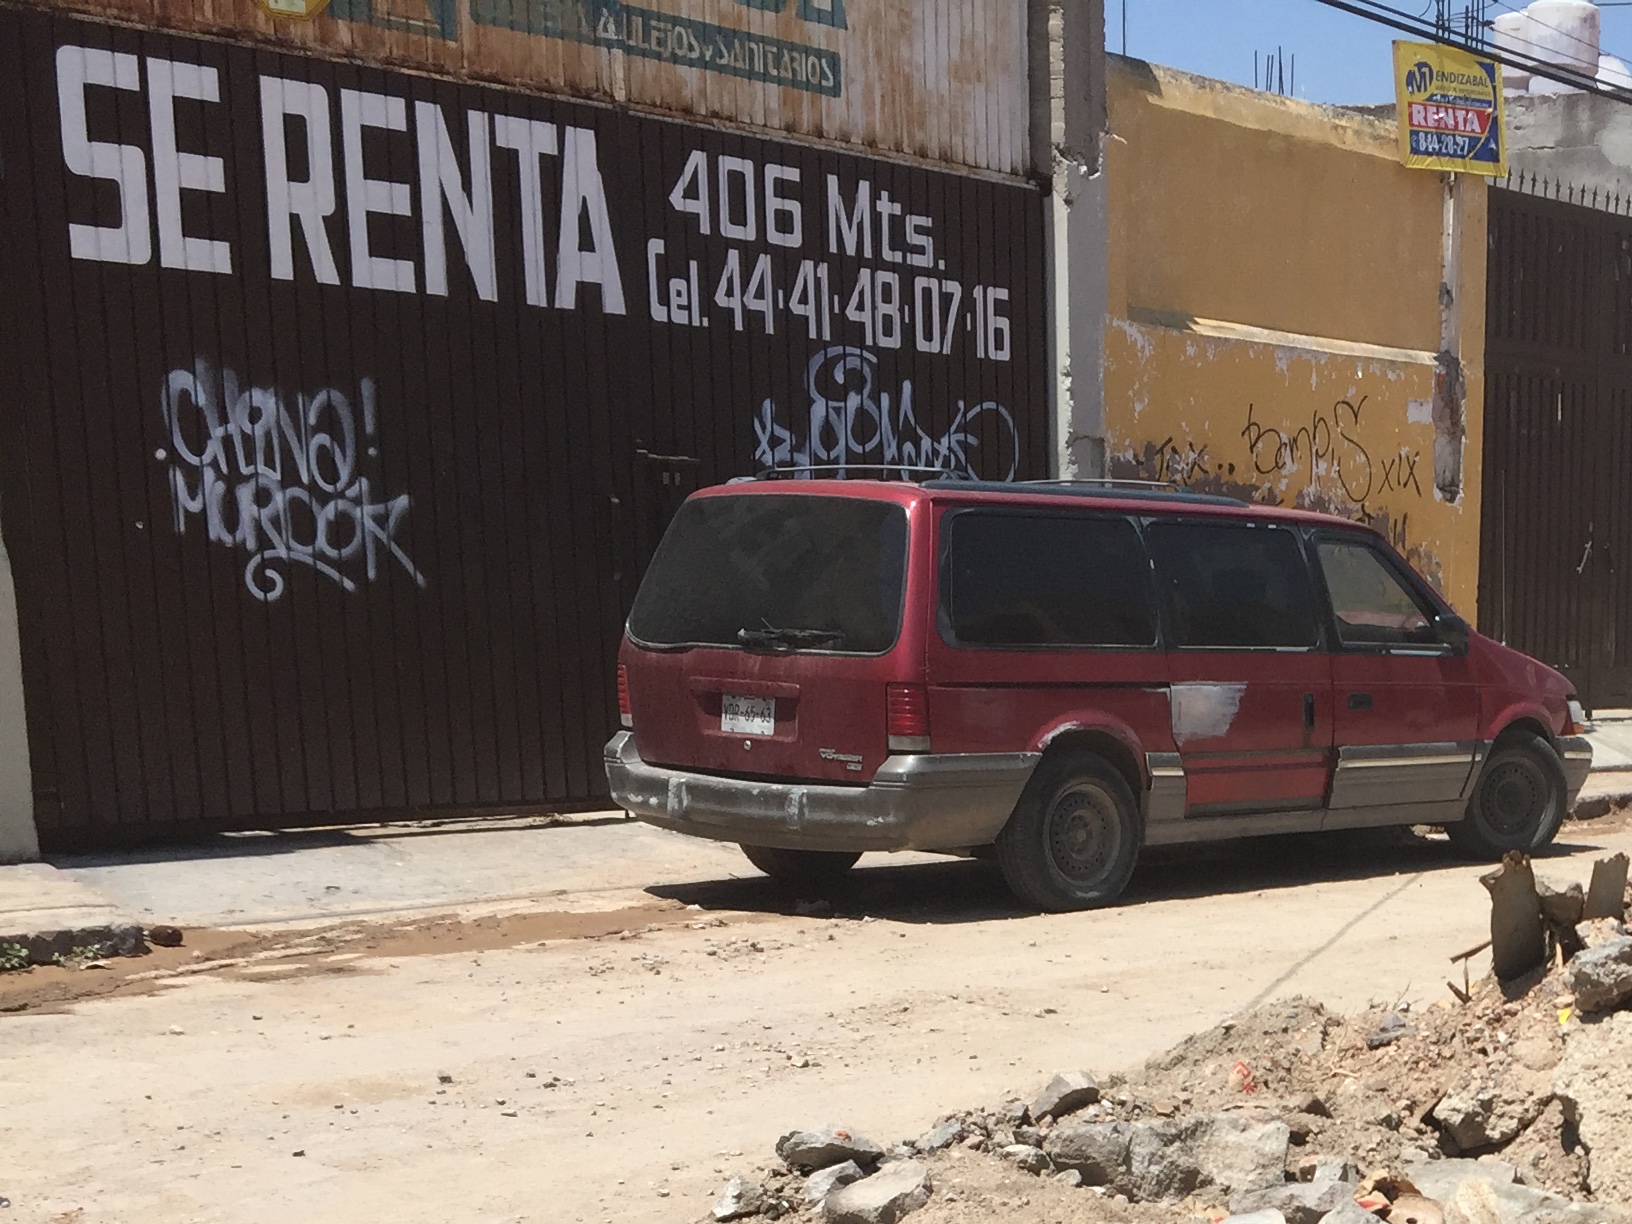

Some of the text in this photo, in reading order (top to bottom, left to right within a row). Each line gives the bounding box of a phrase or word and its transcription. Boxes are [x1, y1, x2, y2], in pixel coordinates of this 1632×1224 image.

[1411, 103, 1482, 133] RENTA
[56, 44, 627, 315] SE RENTA
[668, 149, 946, 271] 406 Mts.
[647, 237, 710, 328] Cel.
